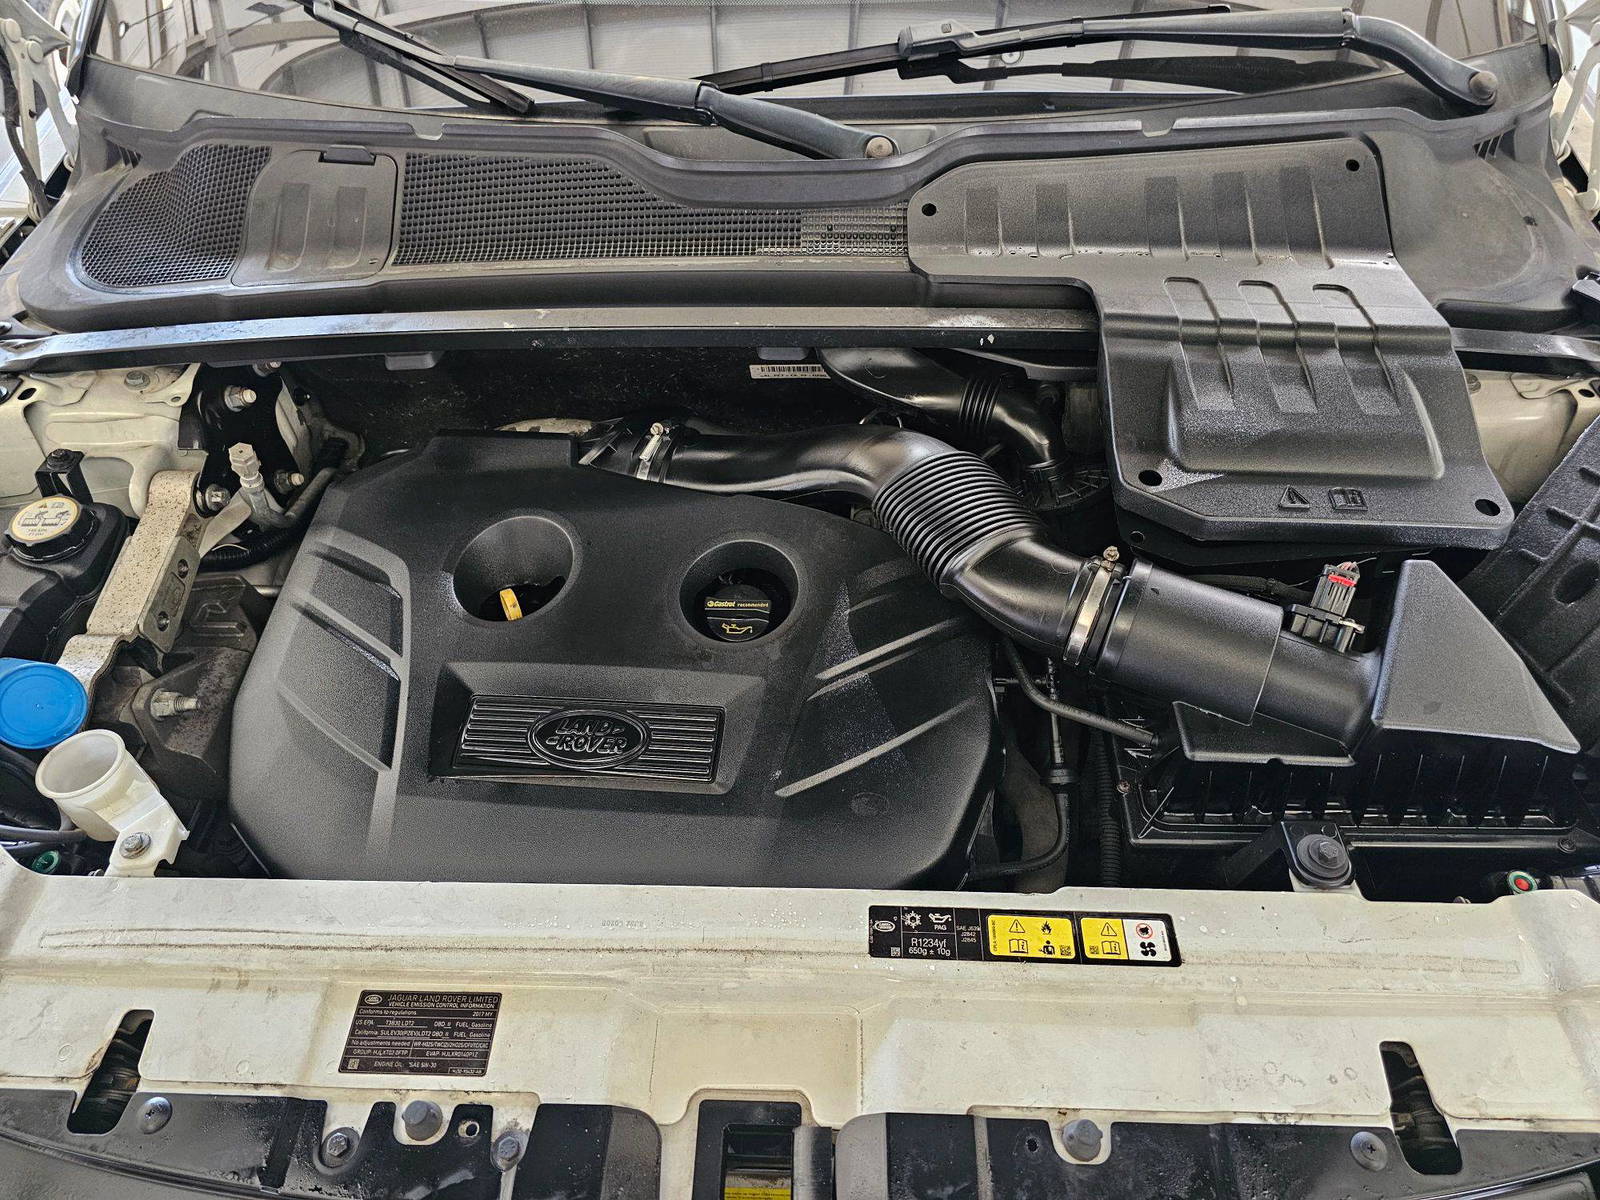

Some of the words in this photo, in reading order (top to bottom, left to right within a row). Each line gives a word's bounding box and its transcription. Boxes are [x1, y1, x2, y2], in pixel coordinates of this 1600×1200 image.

[713, 600, 735, 608] Castrol
[911, 937, 947, 949] R1234yf
[908, 947, 928, 956] 650g
[936, 948, 951, 957] 10g
